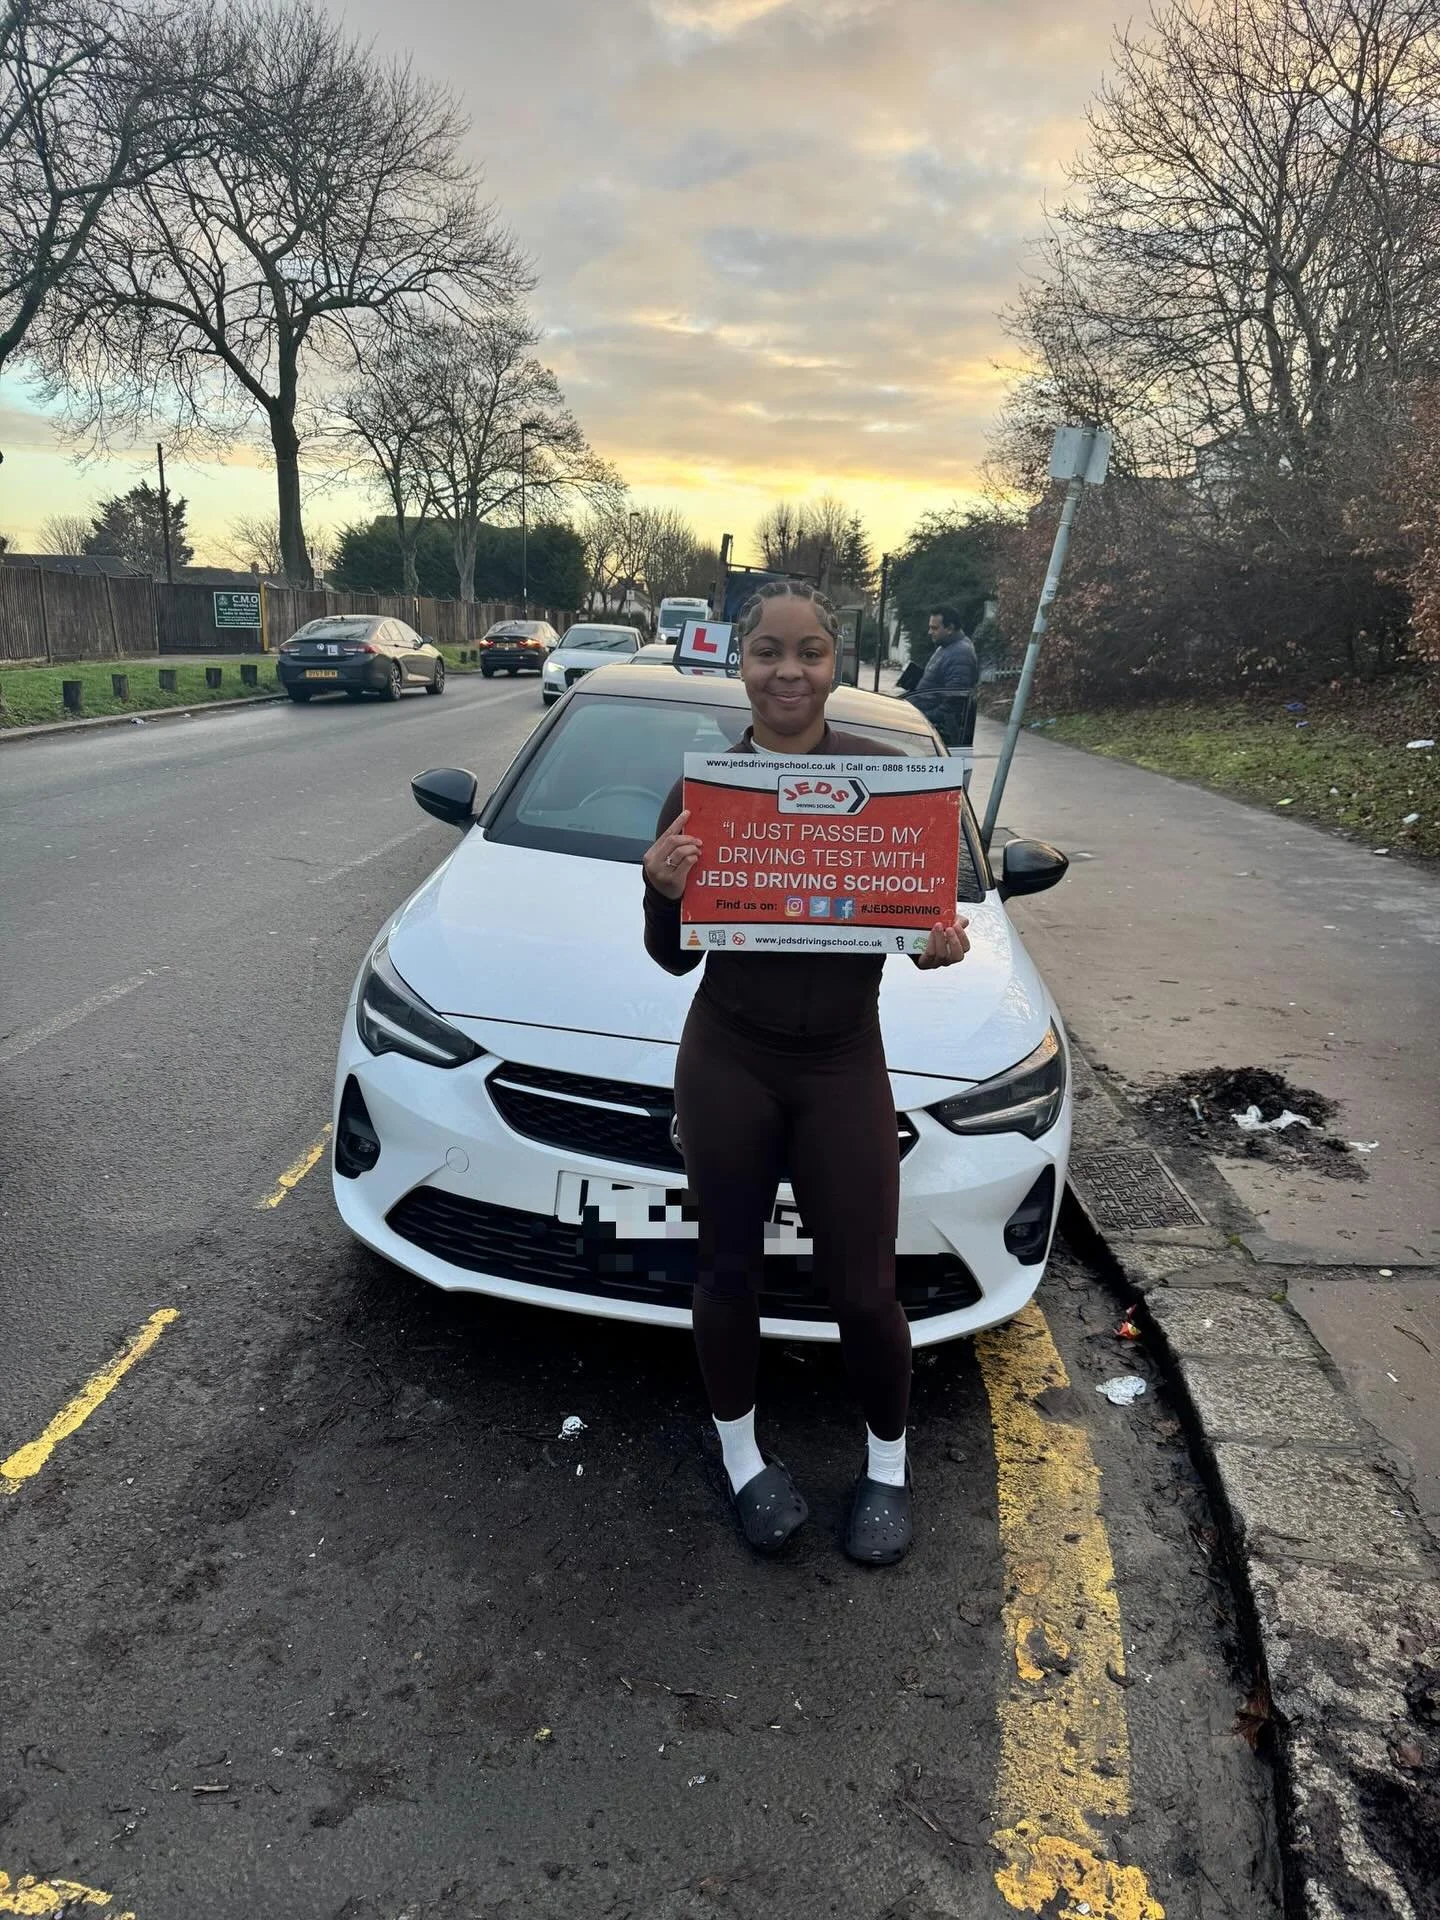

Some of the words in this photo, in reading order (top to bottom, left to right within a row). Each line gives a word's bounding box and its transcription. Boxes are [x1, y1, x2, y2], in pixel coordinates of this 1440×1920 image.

[692, 628, 717, 653] L
[706, 759, 836, 771] www.jedsdrivingschool.co.uk
[846, 762, 863, 771] Call
[865, 764, 880, 772] on:
[882, 764, 903, 772] 0808
[906, 764, 926, 773] 1555
[928, 765, 945, 773] 214
[783, 781, 849, 803] JEDS
[742, 822, 795, 840] JUST
[801, 824, 885, 843] PASSED
[892, 826, 924, 844] MY
[719, 846, 806, 866] DRIVING
[811, 849, 866, 867] TEST
[872, 851, 926, 869] WITH
[696, 870, 748, 888] JEDS
[754, 872, 837, 890] DRIVING
[843, 874, 945, 893] SCHOOL!”
[716, 900, 740, 910] Find
[743, 902, 757, 910] us
[760, 902, 777, 911] on:
[861, 904, 941, 916] #JEDSDRIVING
[755, 937, 882, 948] www.jedsdrivingschool.co.uk
